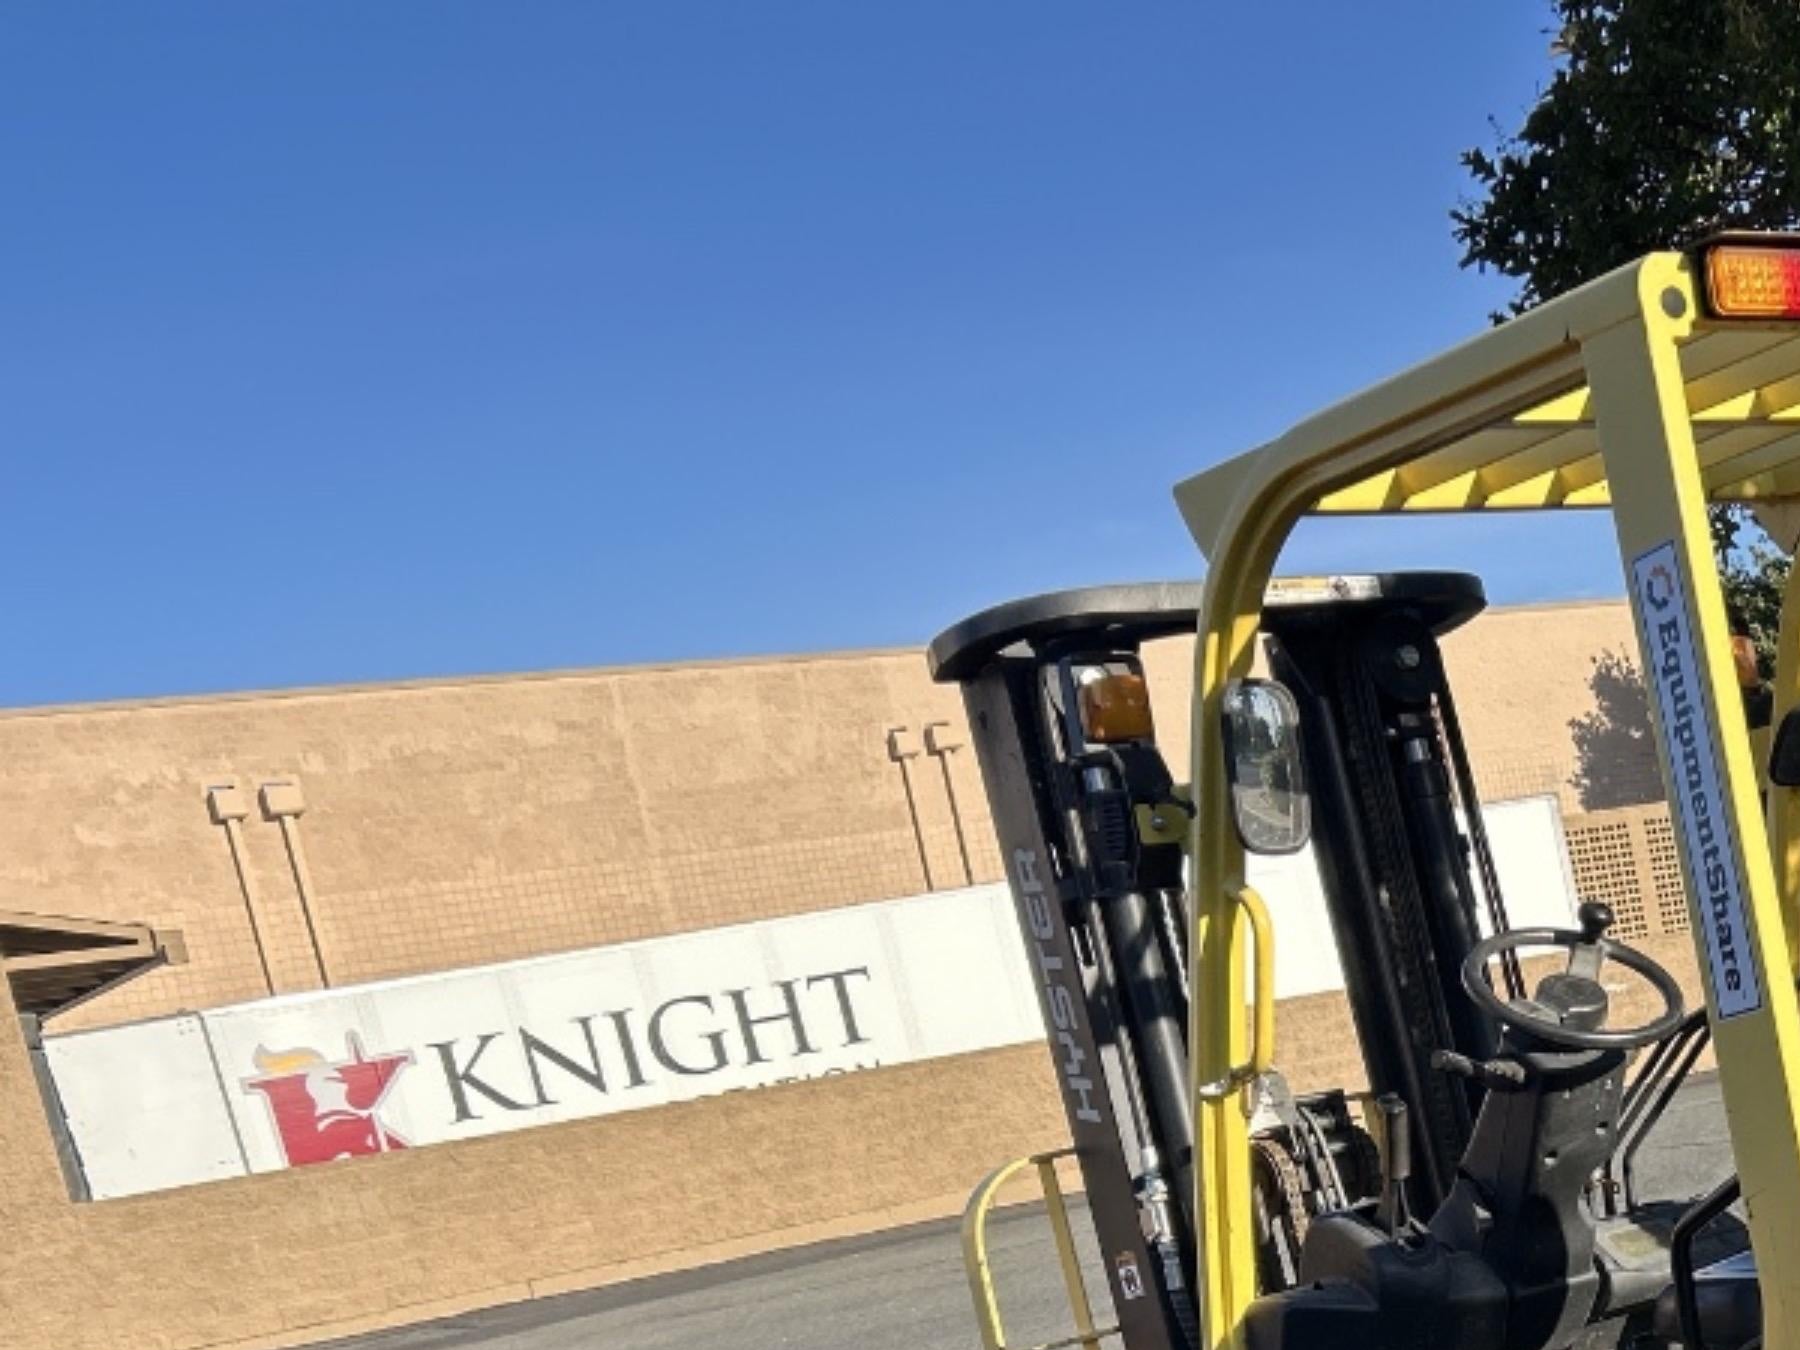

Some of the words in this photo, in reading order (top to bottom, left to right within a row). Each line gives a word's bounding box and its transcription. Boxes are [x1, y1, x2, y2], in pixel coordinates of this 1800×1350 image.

[1658, 619, 1742, 994] EquipmentShare
[426, 966, 871, 1124] KNIGHT
[1013, 848, 1101, 1124] HYSTER
